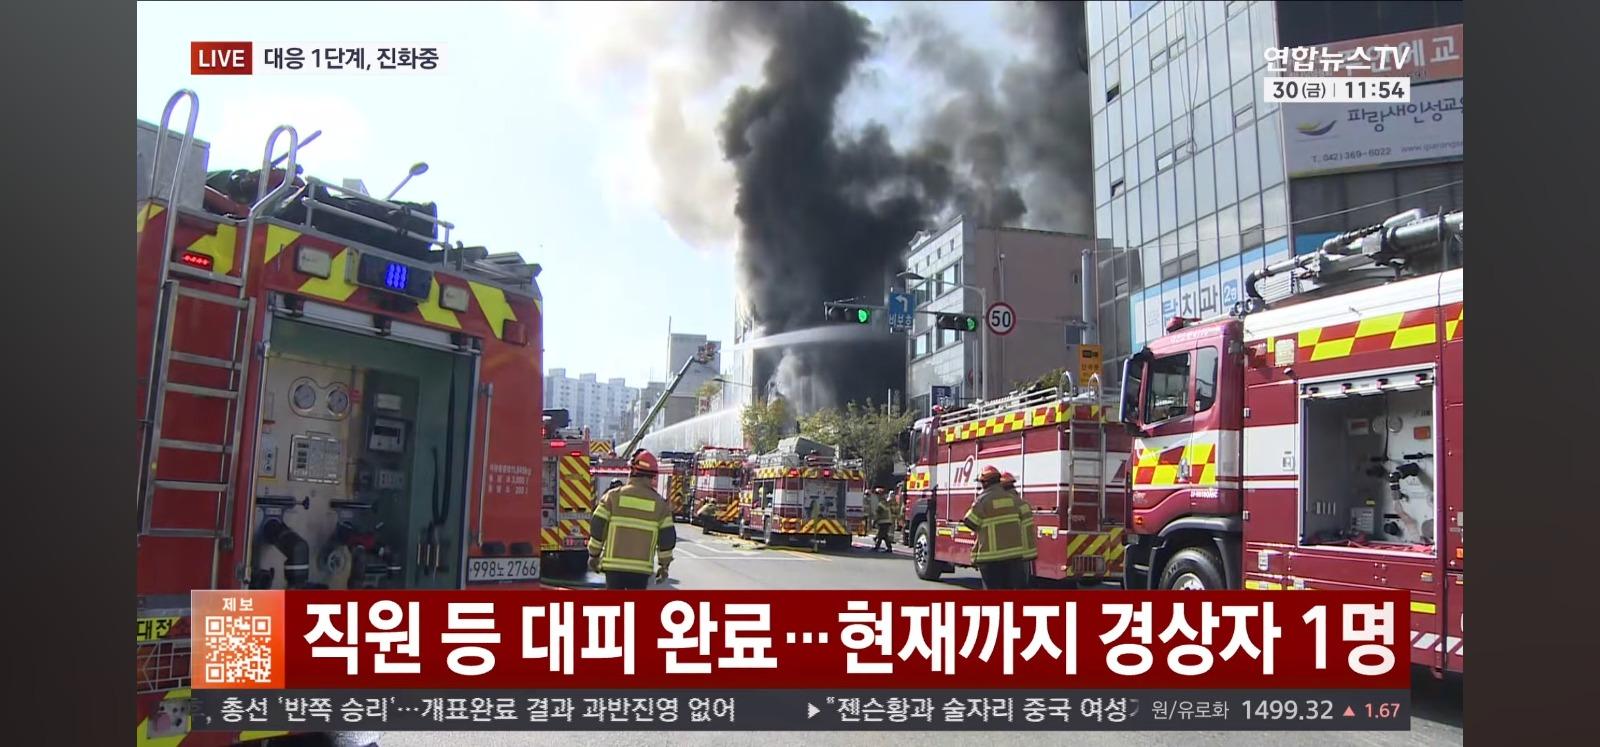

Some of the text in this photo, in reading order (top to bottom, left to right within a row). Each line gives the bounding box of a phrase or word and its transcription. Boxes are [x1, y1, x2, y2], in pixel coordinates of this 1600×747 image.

[1347, 97, 1463, 132] 파랑새인성교
[888, 313, 912, 329] 비보호
[991, 309, 1012, 328] 50
[953, 454, 975, 484] 119
[507, 560, 537, 577] 2766
[137, 618, 173, 640] 대전
